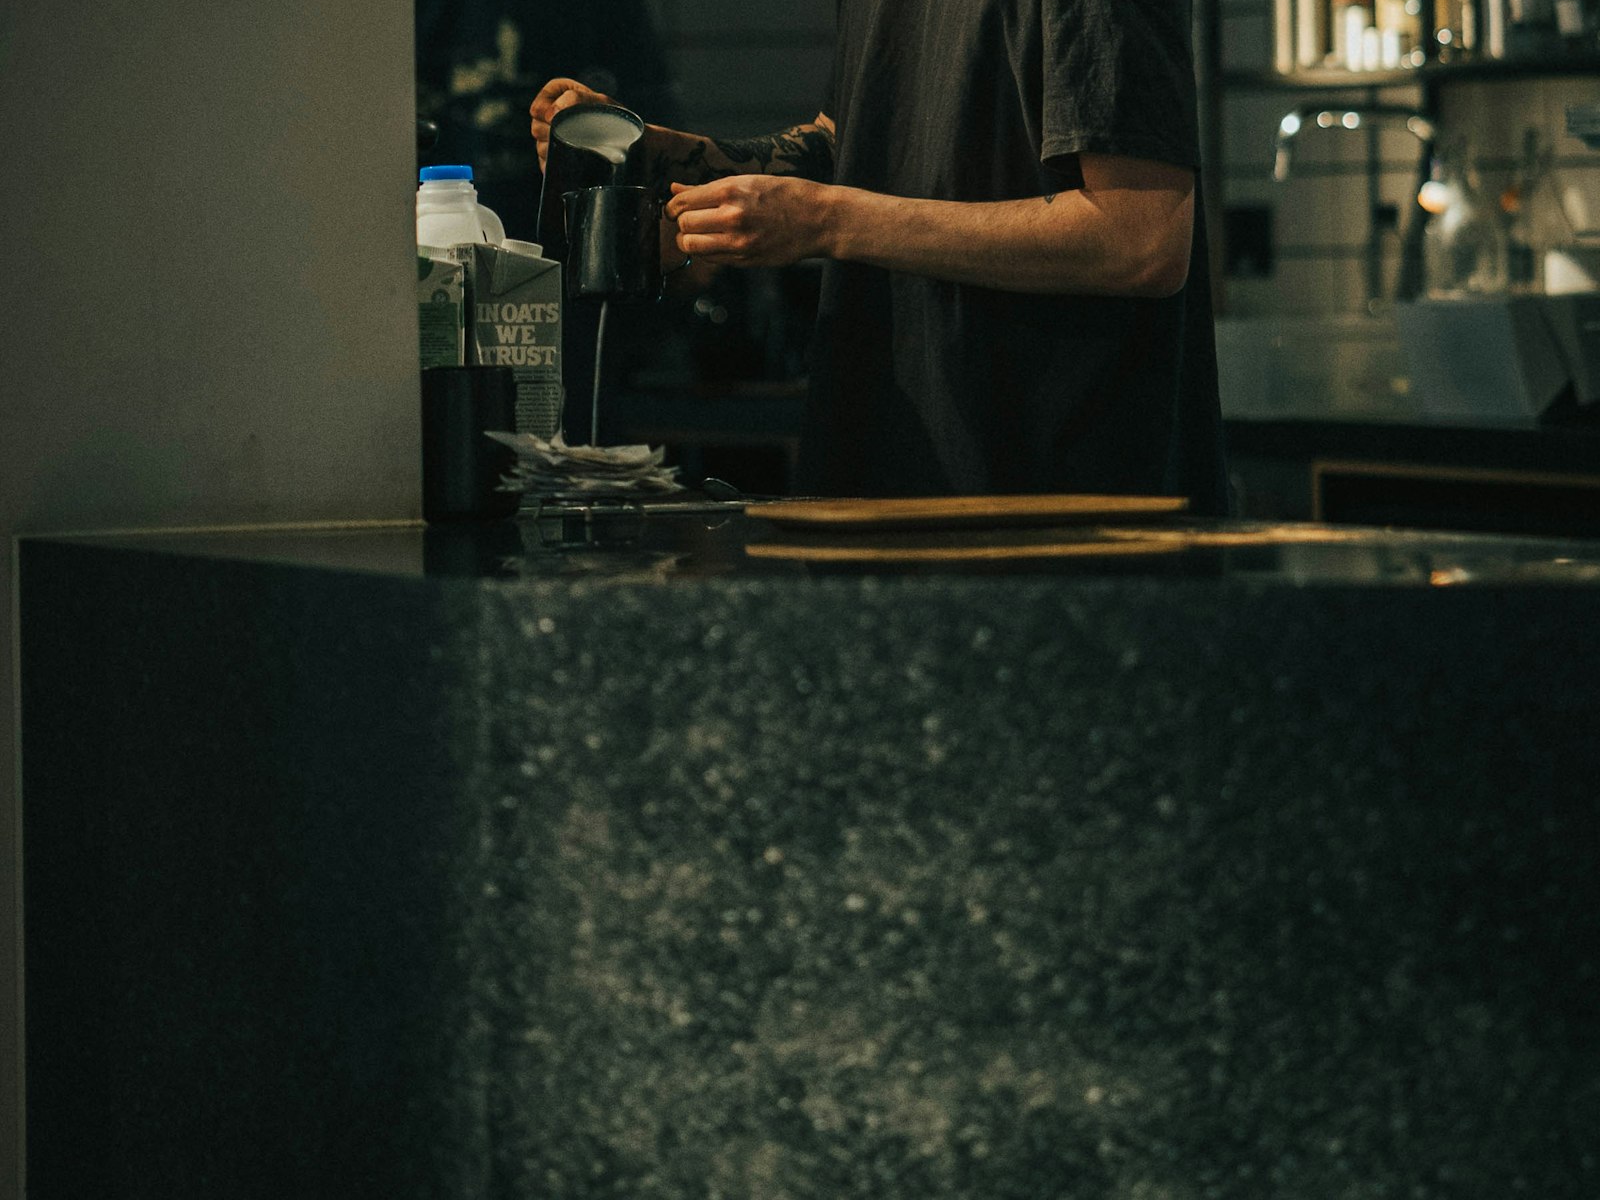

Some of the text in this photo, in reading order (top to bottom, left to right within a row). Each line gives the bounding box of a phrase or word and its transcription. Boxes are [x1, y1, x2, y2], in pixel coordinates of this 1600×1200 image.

[476, 302, 560, 323] IN OATS
[494, 325, 536, 345] WE
[482, 346, 557, 366] TRUST
